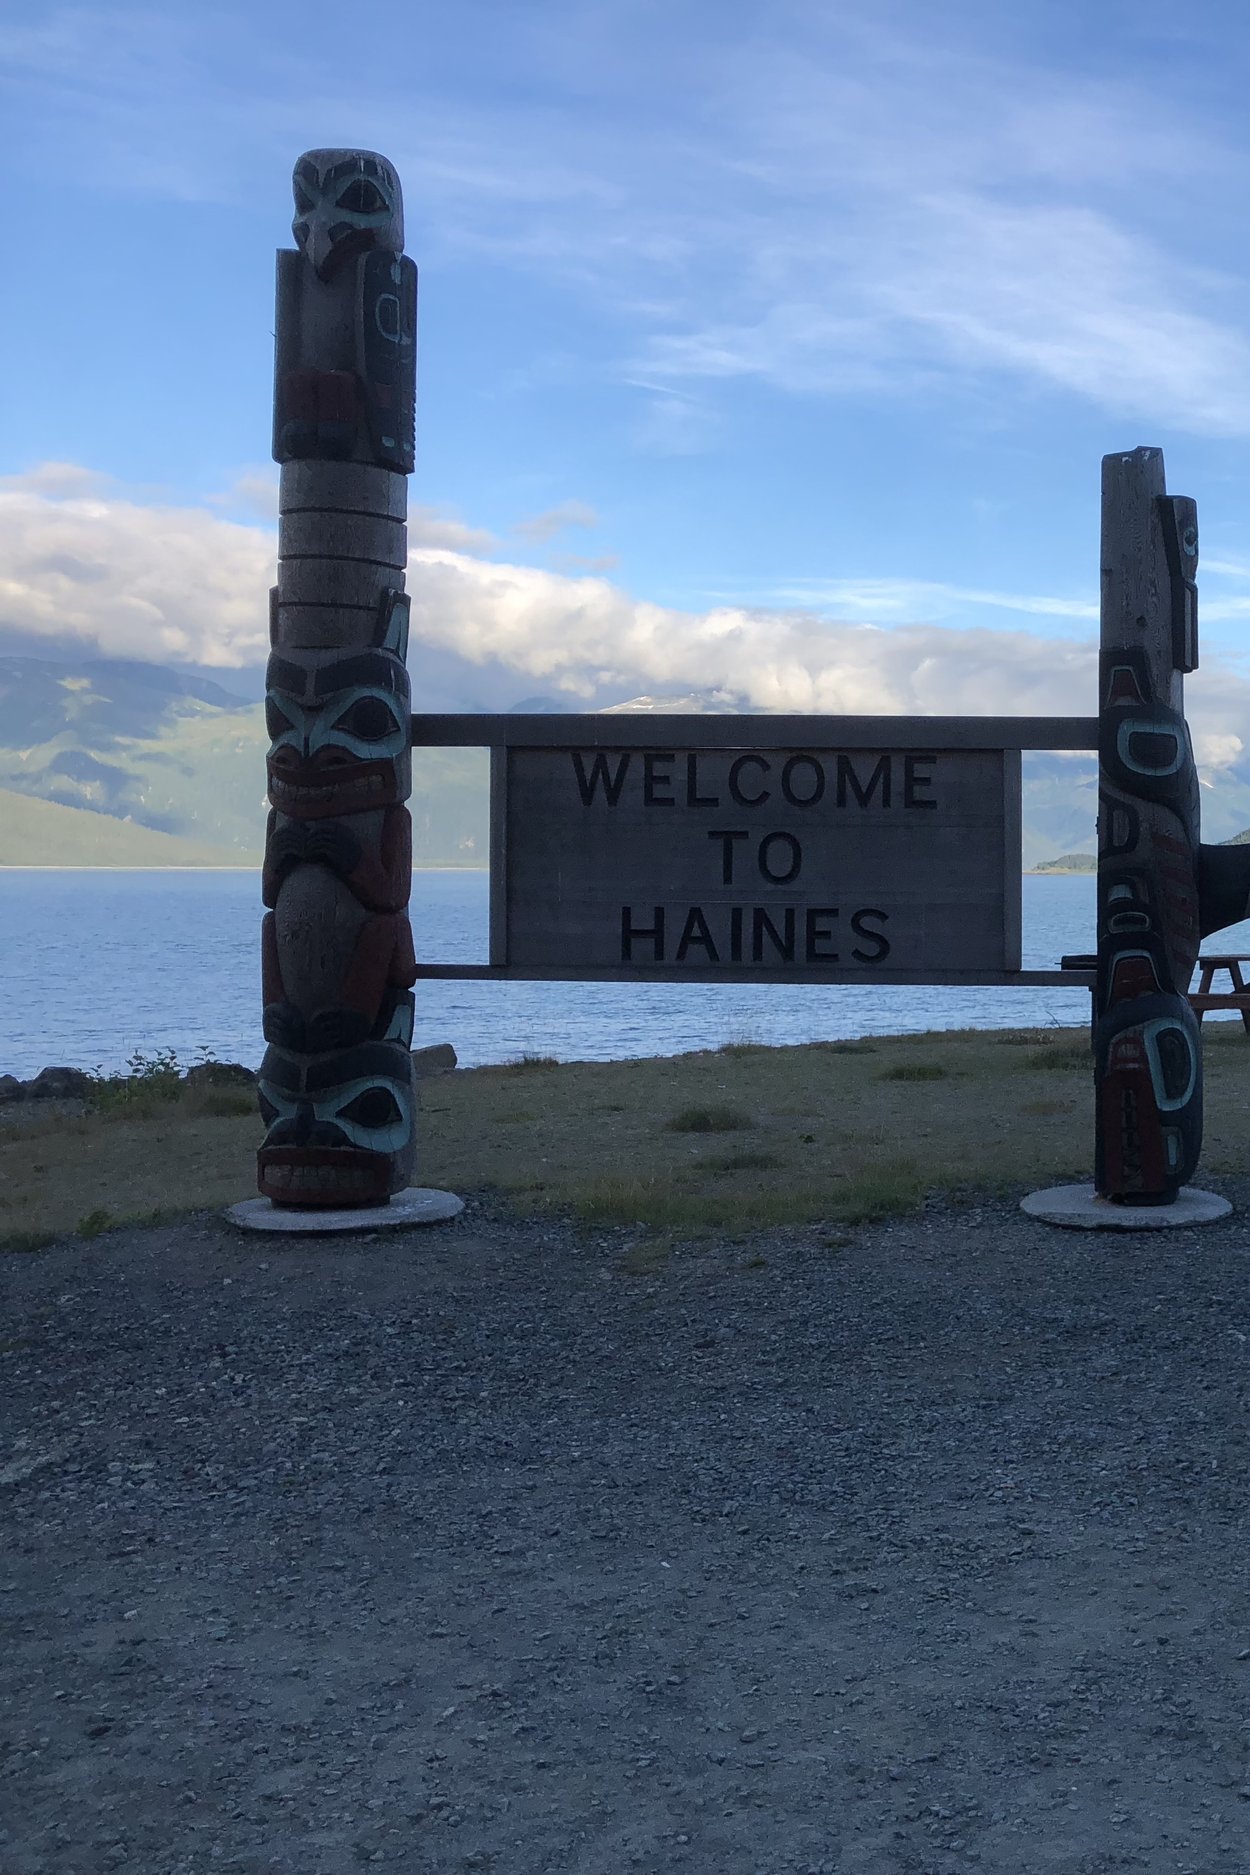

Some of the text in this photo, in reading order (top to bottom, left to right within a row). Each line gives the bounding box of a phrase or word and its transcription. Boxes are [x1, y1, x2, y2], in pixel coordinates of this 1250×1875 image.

[571, 752, 938, 810] WELCOME
[707, 830, 803, 886] TO
[621, 906, 891, 964] HAINES
